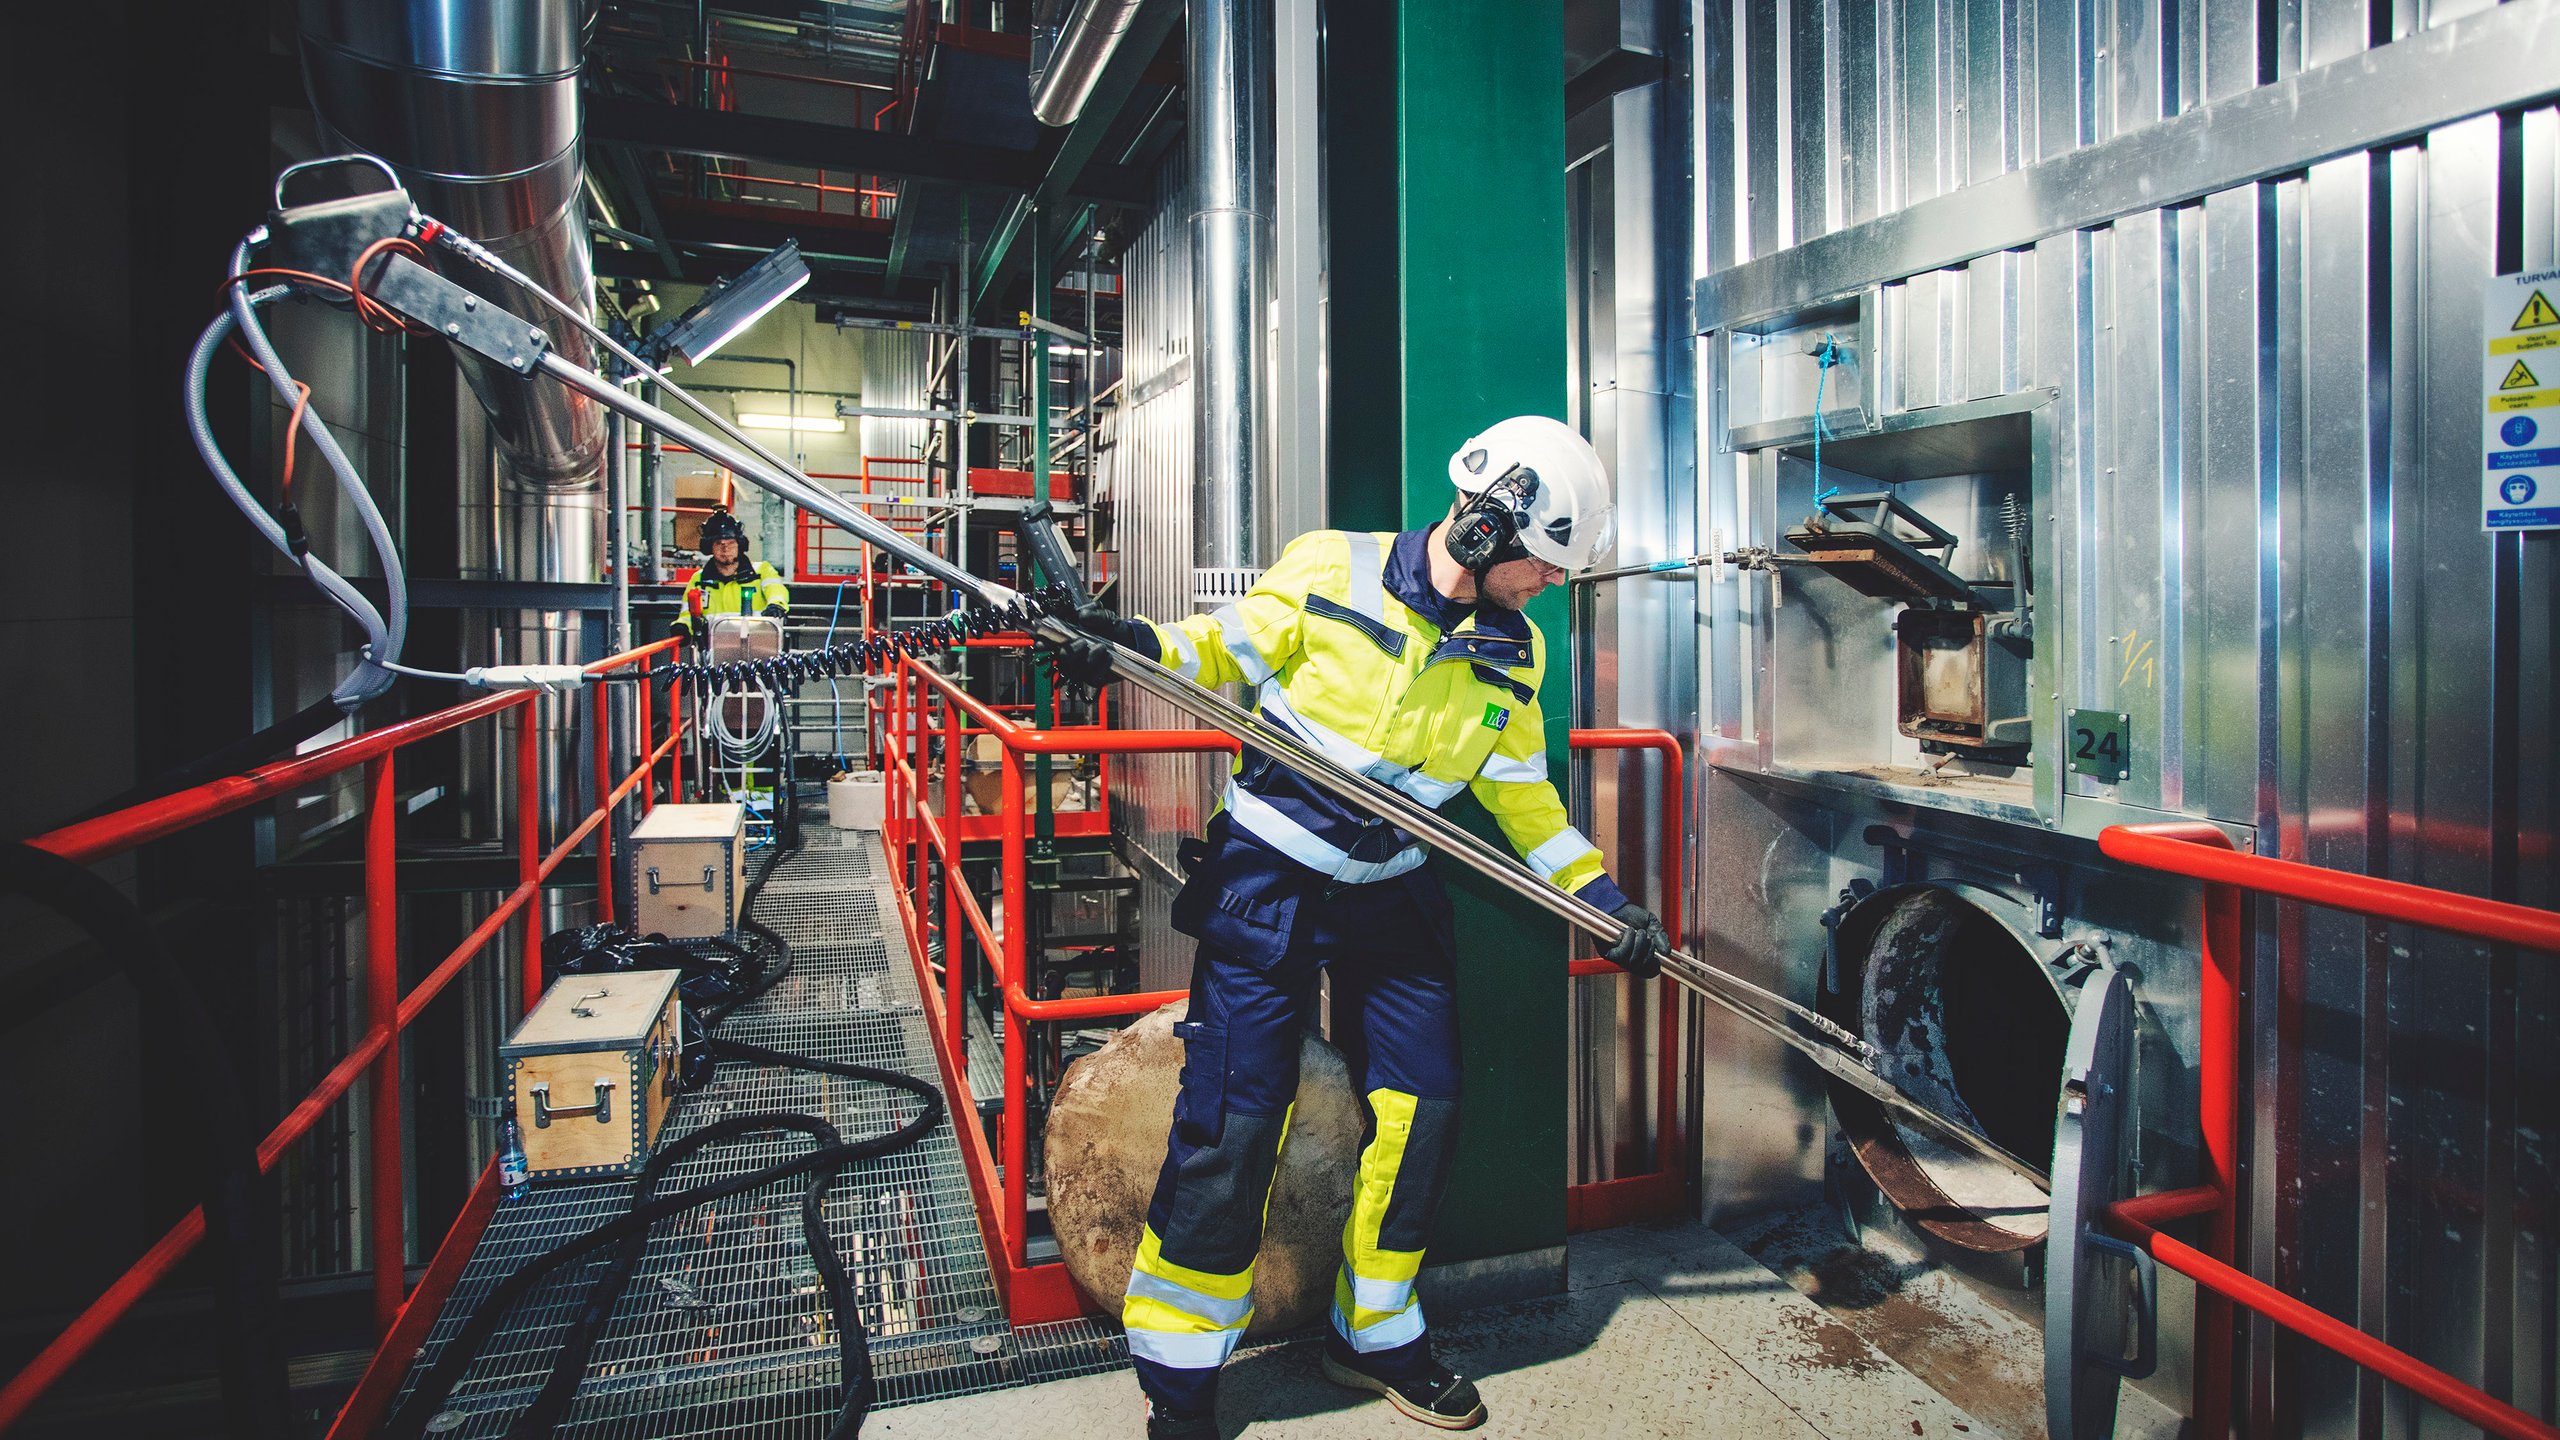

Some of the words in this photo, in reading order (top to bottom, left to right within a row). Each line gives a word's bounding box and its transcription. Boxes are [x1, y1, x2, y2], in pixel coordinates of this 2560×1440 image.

[2515, 270, 2560, 285] TURVA
[2119, 629, 2153, 688] 1/1
[1487, 709, 1508, 729] L&T
[2076, 728, 2121, 763] 24
